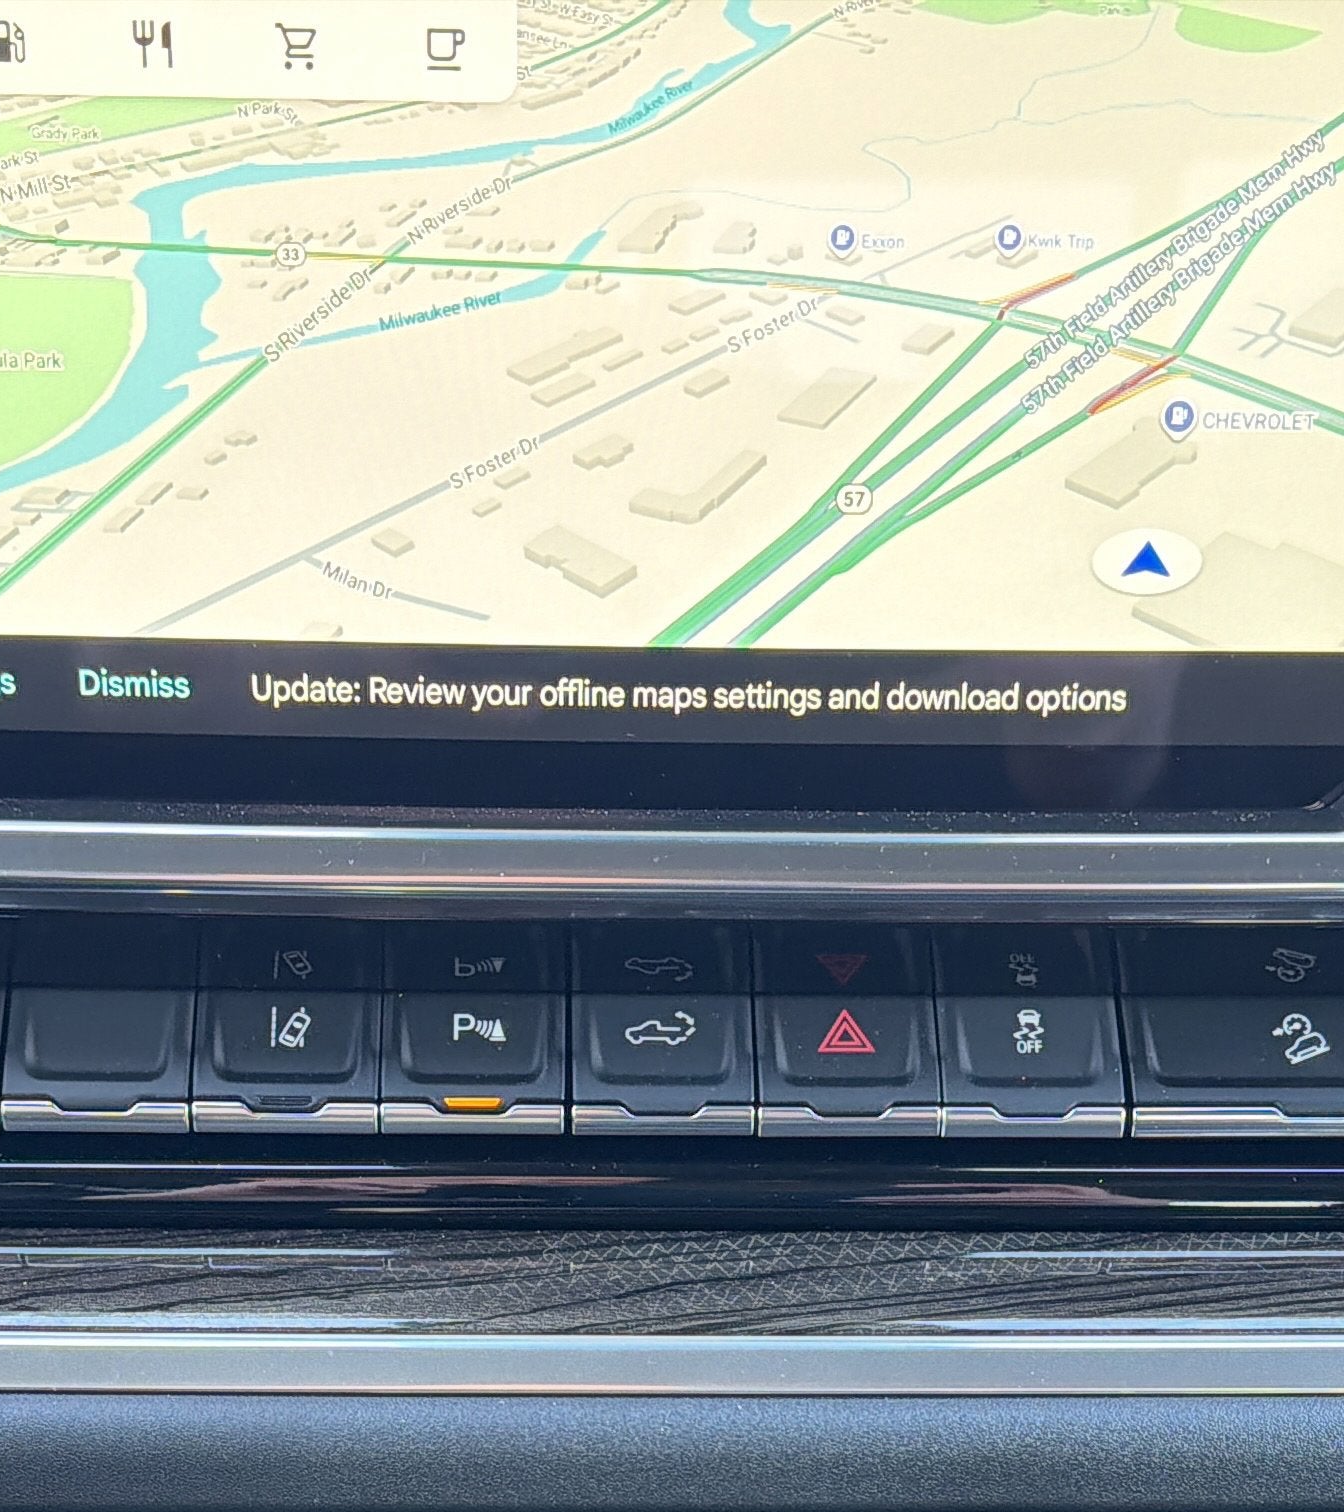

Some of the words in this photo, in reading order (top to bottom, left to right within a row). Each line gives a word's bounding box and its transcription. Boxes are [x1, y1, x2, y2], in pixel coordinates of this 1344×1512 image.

[238, 105, 249, 118] N
[251, 101, 282, 117] Park
[608, 94, 666, 135] Milwaukee
[665, 81, 693, 101] River
[31, 126, 68, 139] Grady
[72, 126, 100, 139] Park
[25, 151, 39, 164] St
[0, 187, 14, 201] N
[18, 179, 47, 199] Mill
[52, 175, 71, 191] St
[407, 224, 424, 244] N
[422, 188, 490, 235] Riverside
[490, 176, 513, 197] Dr
[282, 247, 299, 262] 33
[861, 234, 905, 250] Exxon
[1025, 332, 1065, 369] 57th
[1063, 295, 1111, 337] Field
[1108, 248, 1173, 307] Artillery
[1170, 200, 1240, 256] Brigade
[1237, 163, 1284, 204] Mem
[1283, 130, 1325, 169] Hwy
[1028, 233, 1062, 250] Kwik
[1066, 233, 1094, 253] Trip
[1022, 376, 1065, 414] 57th
[1062, 340, 1108, 380] Field
[1108, 283, 1177, 346] Artillery
[1174, 233, 1247, 290] Brigade
[1243, 192, 1292, 236] Mem
[1292, 162, 1338, 200] Hwy
[263, 343, 282, 362] S
[279, 287, 349, 353] Riverside
[349, 265, 374, 292] Dr
[378, 300, 461, 332] Milwaukee
[461, 290, 503, 315] River
[727, 334, 741, 354] S
[742, 311, 795, 346] Foster
[796, 297, 819, 319] Dr
[23, 351, 63, 369] Park
[1202, 411, 1315, 432] CHEVROLET
[450, 472, 464, 489] S
[465, 448, 520, 484] Foster
[518, 437, 540, 456] Dr
[844, 491, 865, 508] 57
[322, 560, 369, 592] Milan
[371, 581, 394, 600] Dr
[79, 667, 191, 698] Dismiss
[251, 674, 361, 708] Update:
[369, 676, 466, 707] Review
[472, 681, 532, 711] your
[540, 677, 626, 708] offline
[633, 684, 707, 714] maps
[713, 680, 821, 716] settings
[828, 682, 880, 711] and
[886, 682, 1020, 712] download
[1026, 683, 1127, 716] options
[1016, 1040, 1044, 1055] OFF
